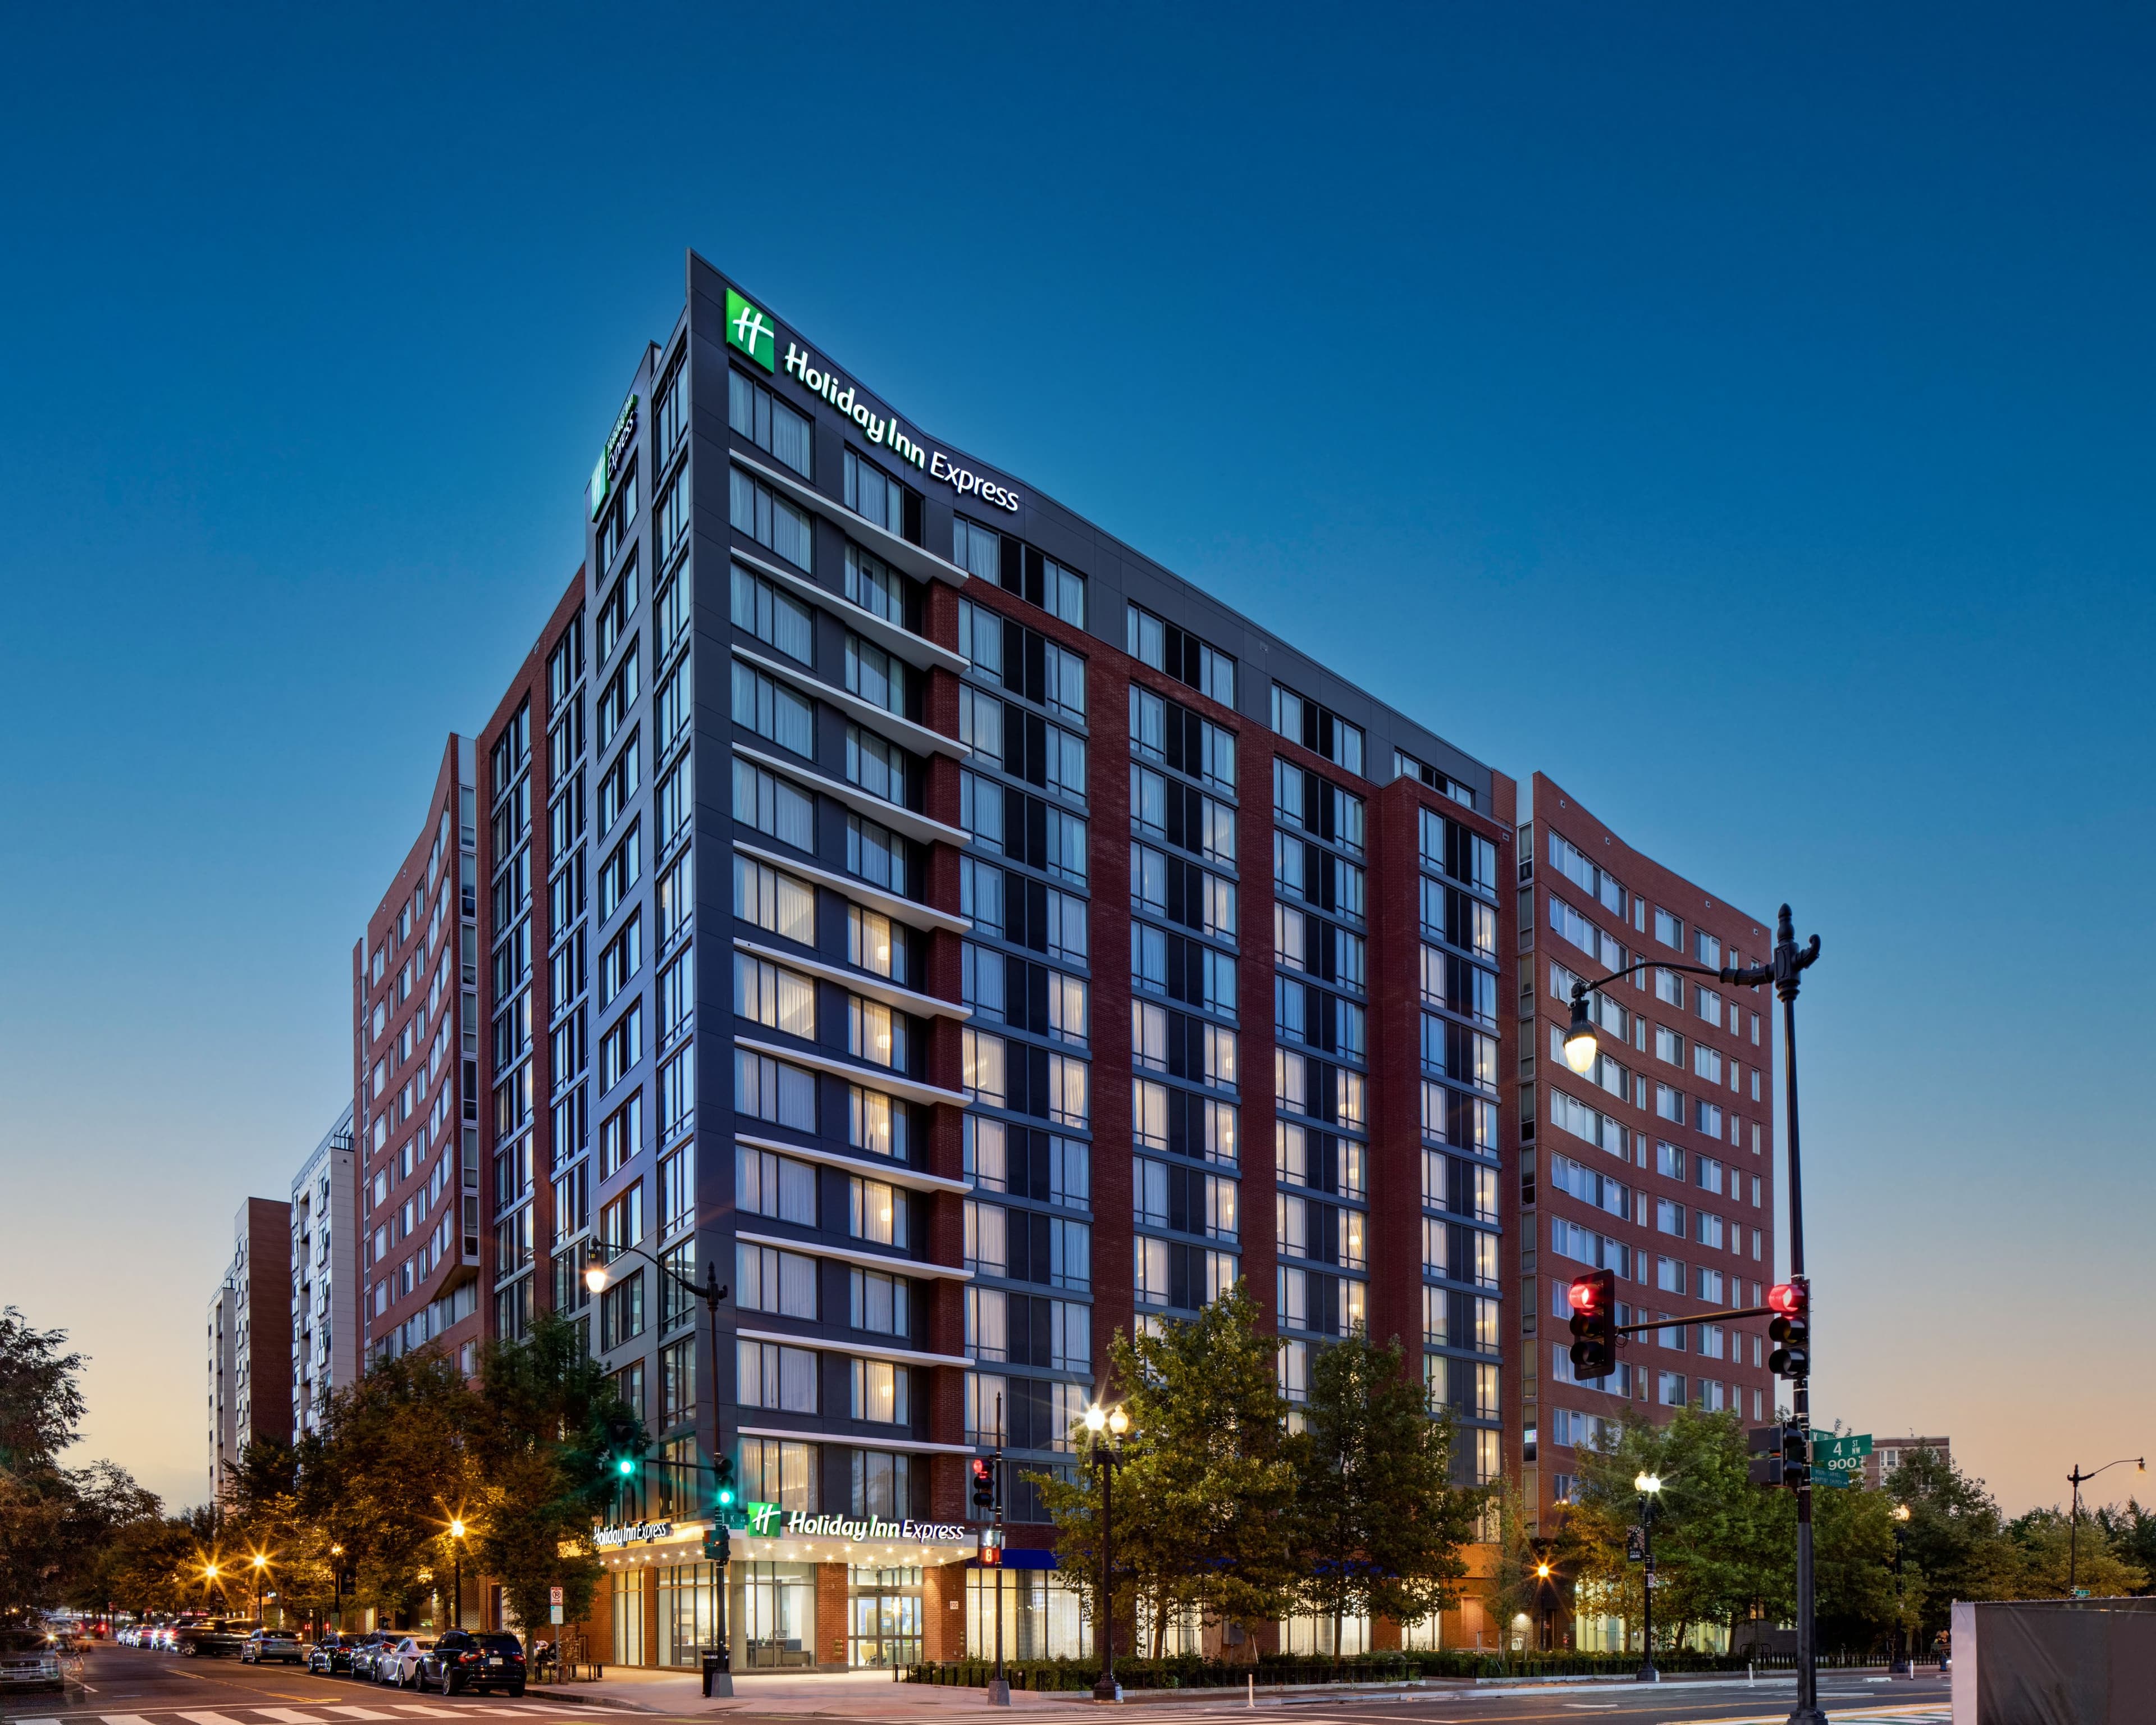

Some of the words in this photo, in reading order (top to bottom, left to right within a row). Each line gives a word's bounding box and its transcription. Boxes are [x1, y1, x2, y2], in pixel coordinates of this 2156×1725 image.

[784, 342, 885, 443] Holiday
[888, 418, 926, 469] Inn
[930, 451, 1020, 512] Express
[607, 411, 634, 480] Express
[1813, 1432, 1818, 1441] K
[1833, 1441, 1842, 1456] 4
[1828, 1457, 1857, 1471] 900
[593, 1523, 623, 1547] Holiday
[623, 1521, 637, 1542] Inn
[637, 1521, 666, 1540] Express
[788, 1510, 867, 1541] Holiday
[869, 1514, 899, 1538] Inn
[902, 1519, 965, 1543] Express
[985, 1548, 993, 1562] 8
